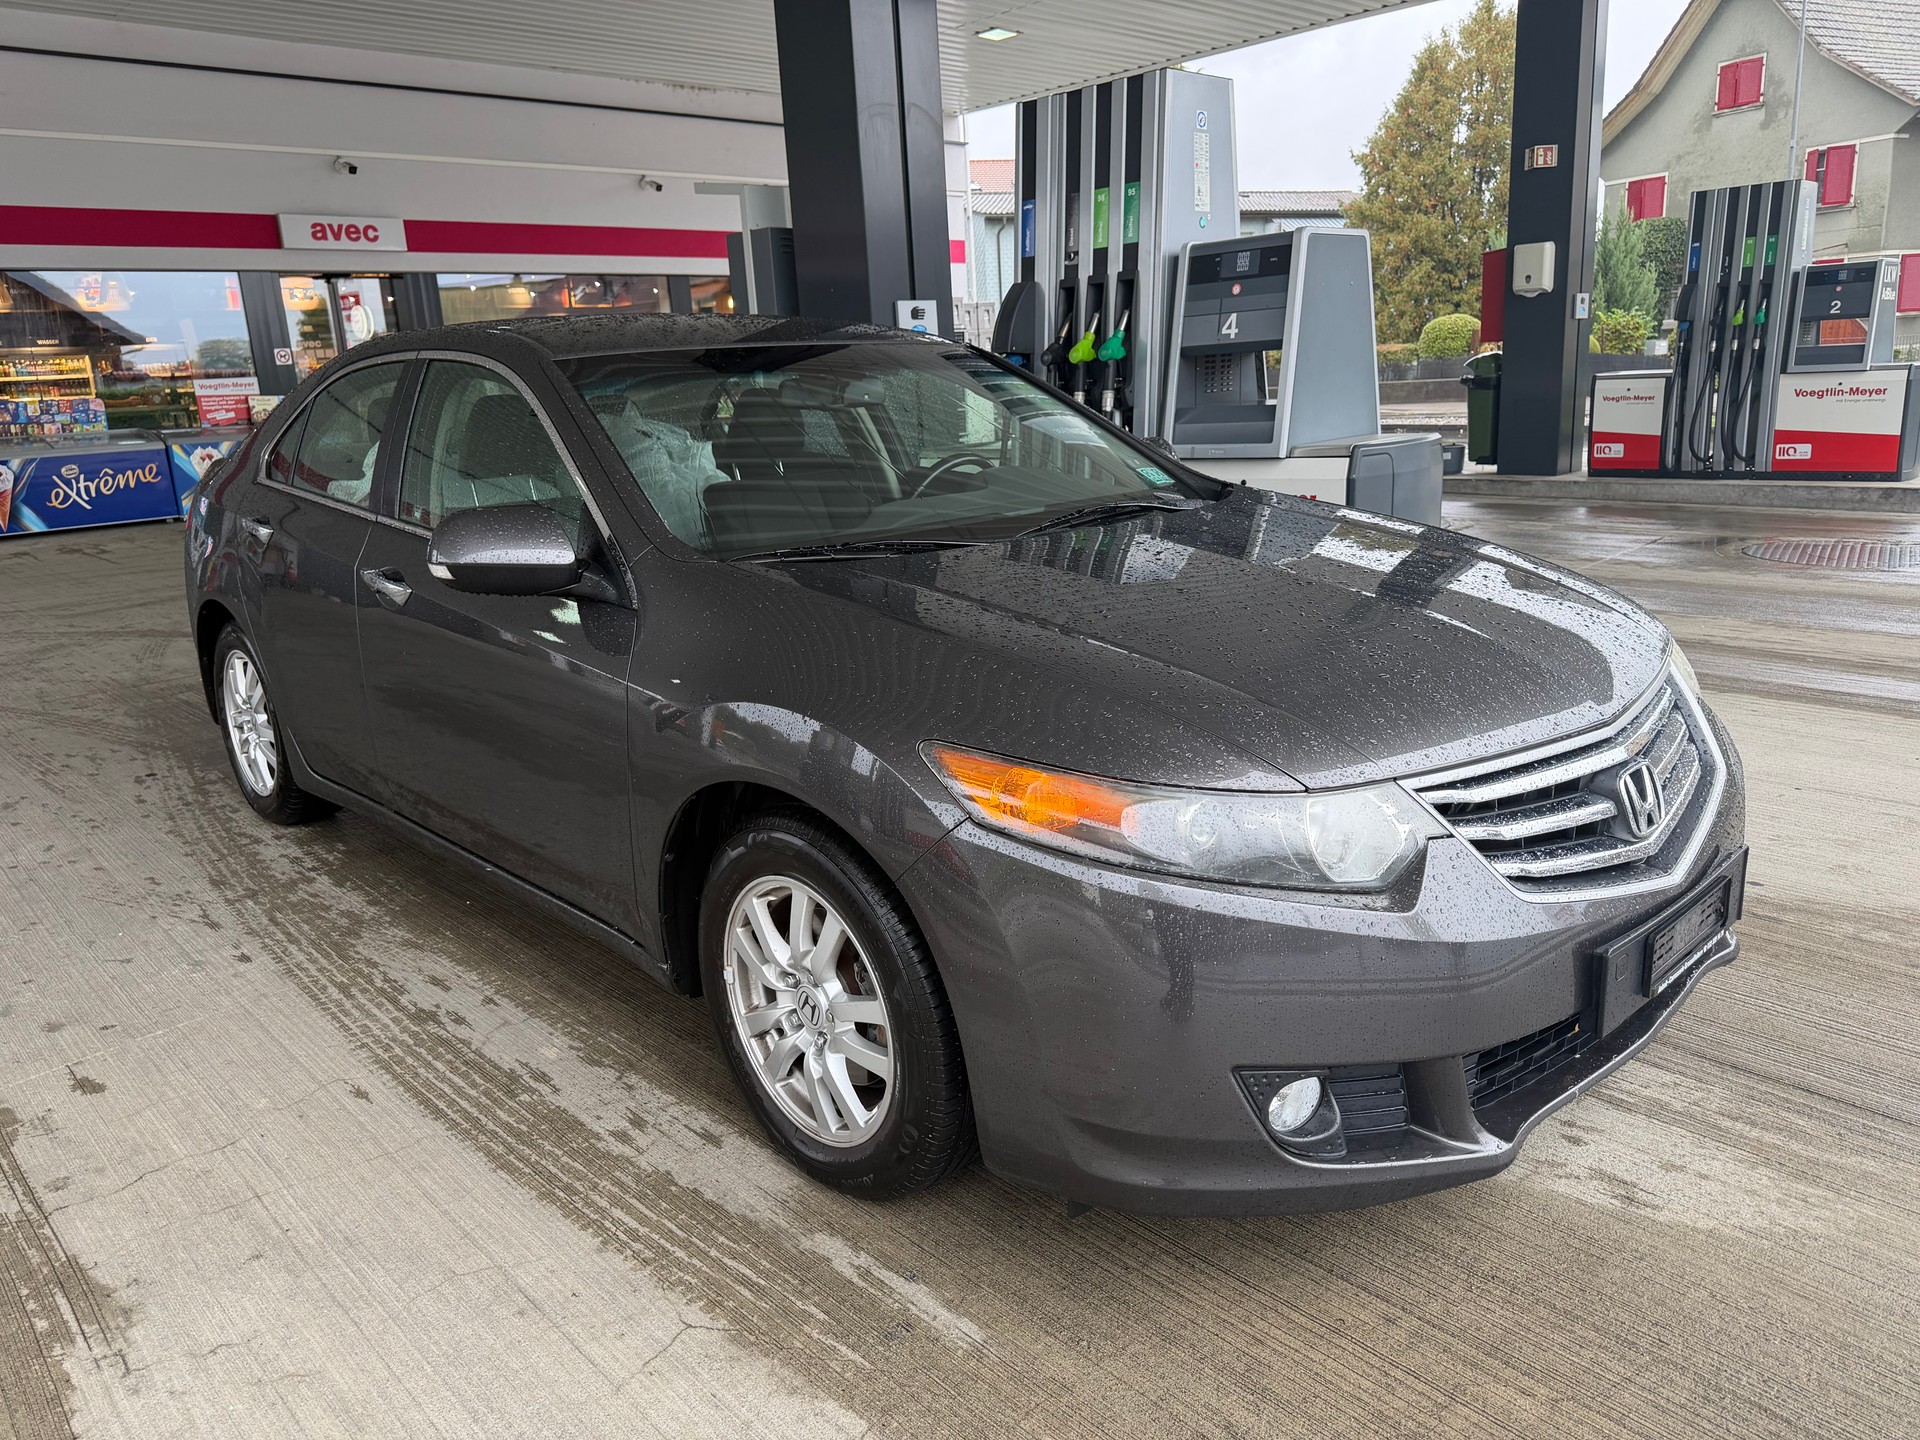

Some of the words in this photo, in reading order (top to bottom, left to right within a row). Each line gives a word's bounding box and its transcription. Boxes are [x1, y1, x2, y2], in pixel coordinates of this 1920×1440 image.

[1127, 188, 1136, 196] 95
[310, 222, 380, 243] avec
[1884, 265, 1897, 282] LKW
[1881, 287, 1895, 300] AdBlue
[1829, 300, 1841, 314] 2
[1221, 313, 1239, 339] 4
[1602, 395, 1655, 403] Voegtlin-Meyer
[1794, 387, 1888, 399] Voegtlin-Meyer
